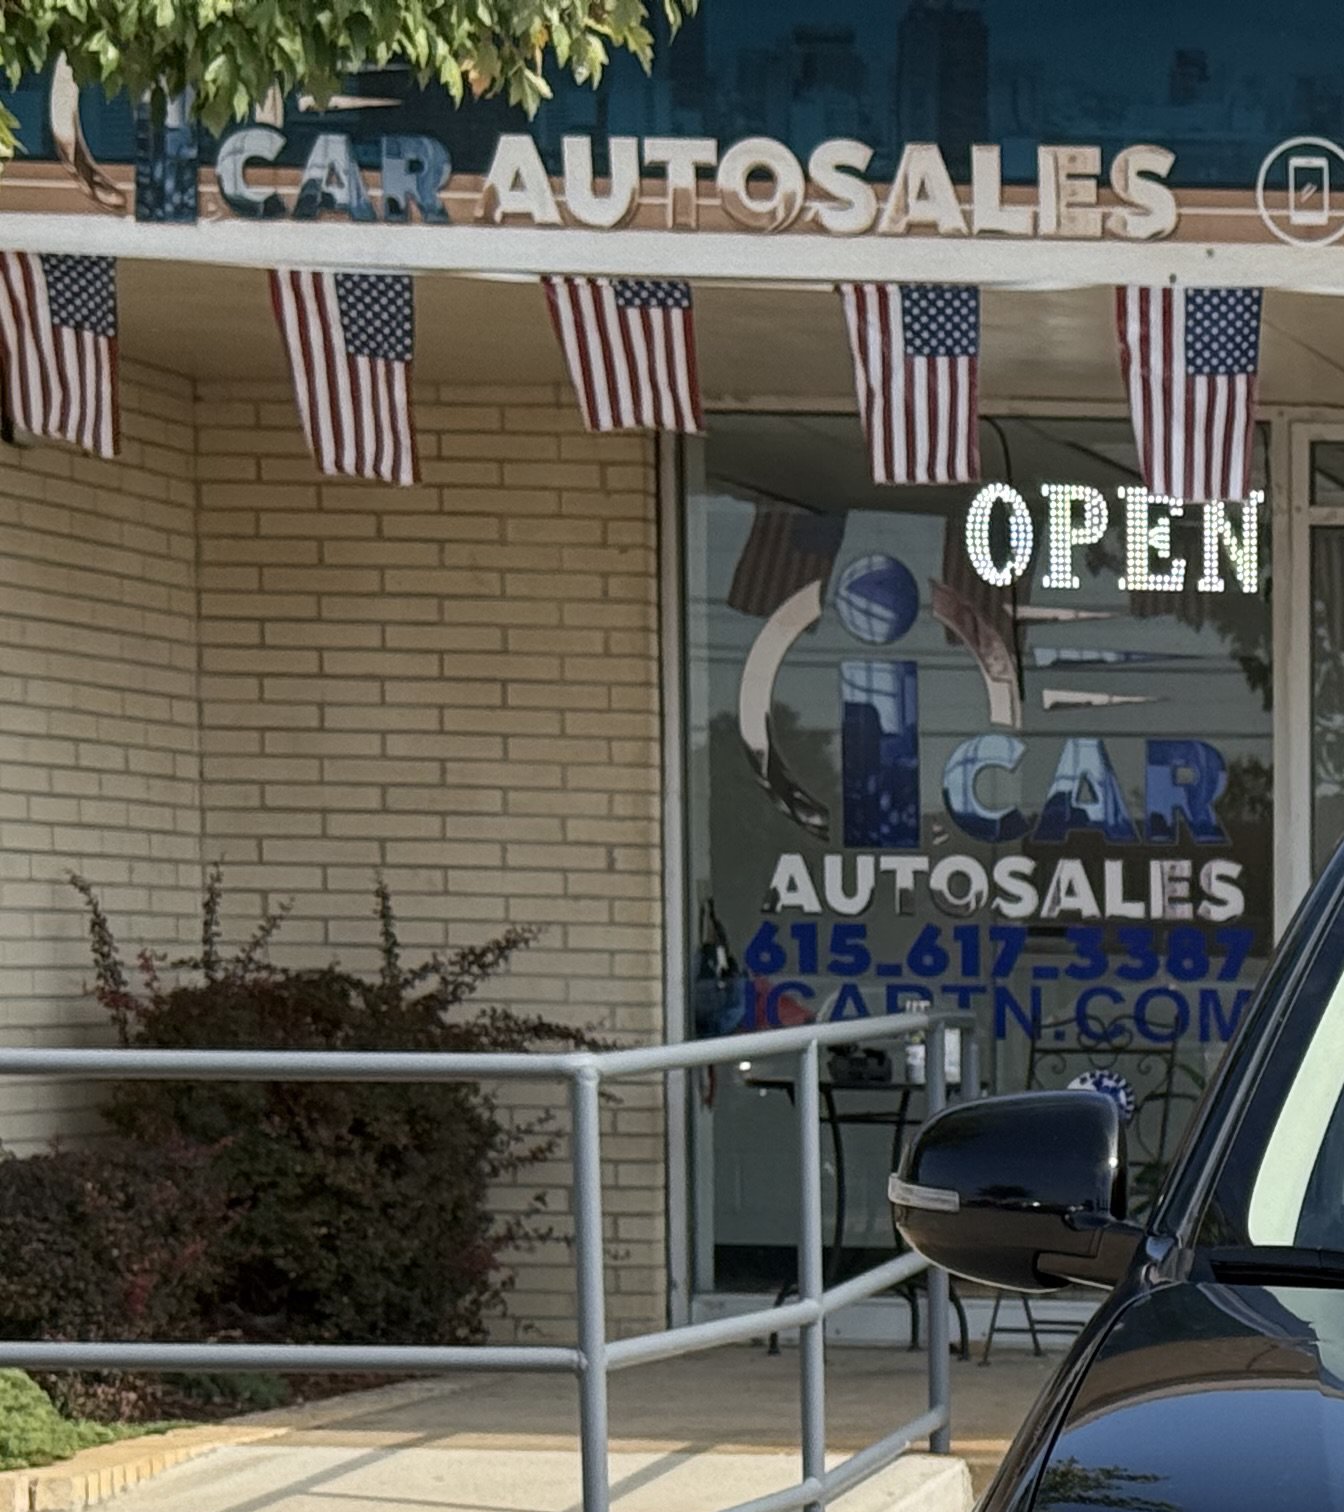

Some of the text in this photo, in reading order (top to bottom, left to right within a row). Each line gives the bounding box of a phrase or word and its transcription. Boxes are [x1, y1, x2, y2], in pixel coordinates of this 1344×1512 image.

[214, 127, 452, 225] CAR
[474, 134, 1180, 241] AUTOSALES
[965, 482, 1265, 593] OPEN
[763, 853, 1246, 922] AUTOSALES
